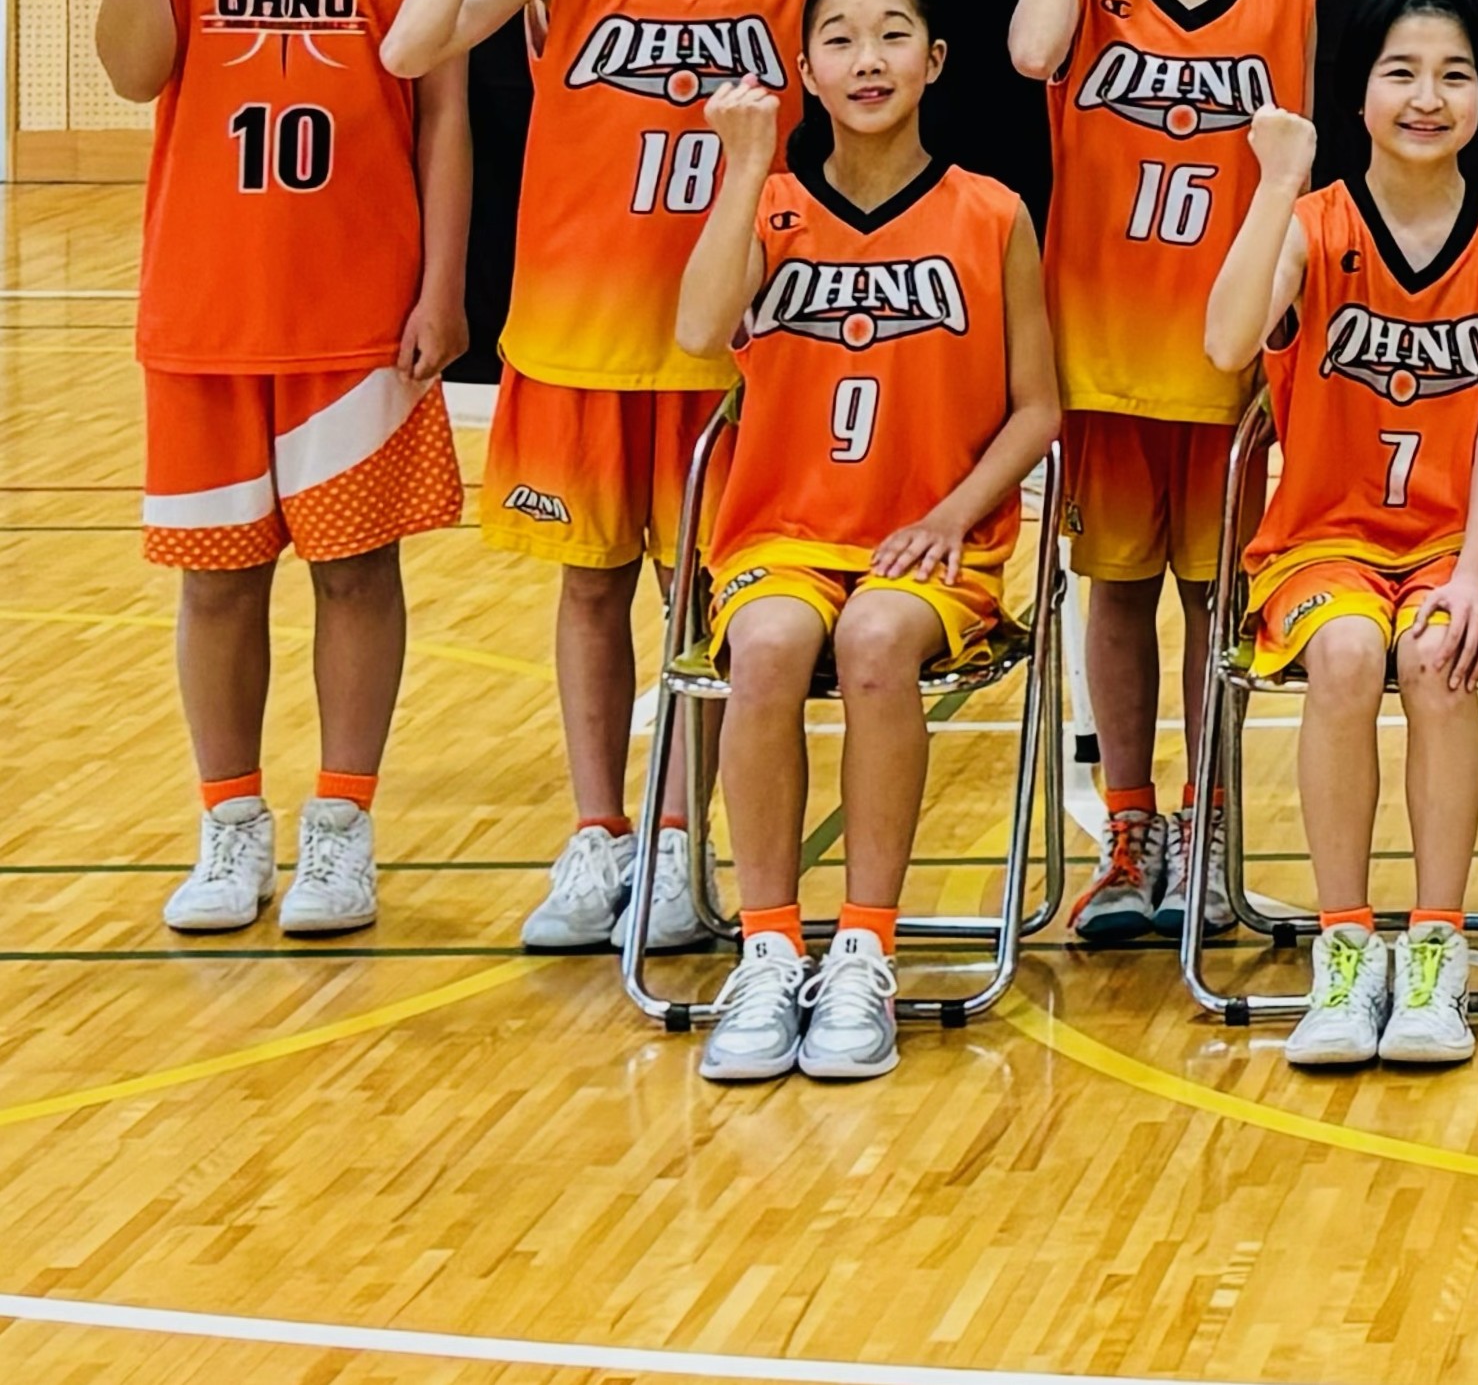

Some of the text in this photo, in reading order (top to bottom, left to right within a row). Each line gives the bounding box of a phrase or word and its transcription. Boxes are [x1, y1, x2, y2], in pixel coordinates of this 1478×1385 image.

[565, 13, 788, 91] OHNO
[1074, 40, 1279, 115] OHNO
[229, 104, 335, 194] 10
[630, 130, 723, 214] 18
[1126, 160, 1219, 246] 16
[750, 256, 968, 337] OHNO
[829, 376, 880, 463] 9
[1380, 430, 1421, 507] 7
